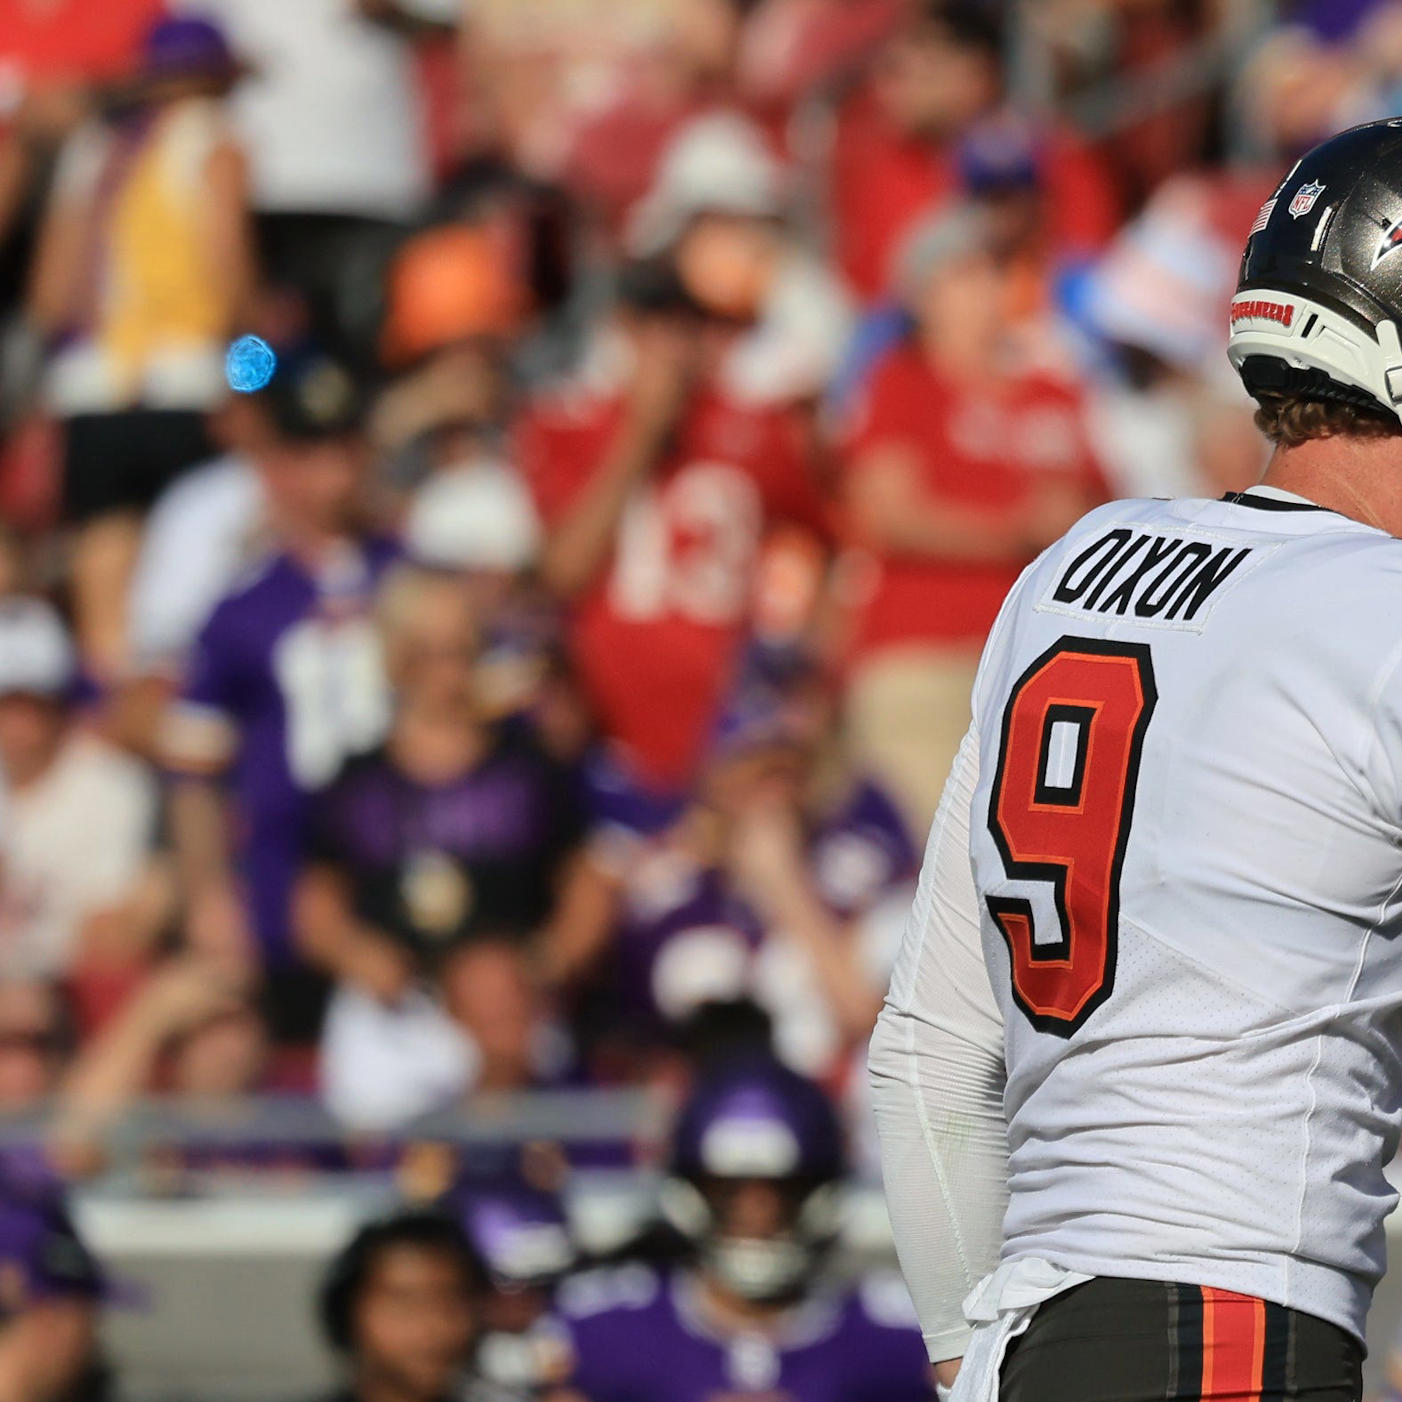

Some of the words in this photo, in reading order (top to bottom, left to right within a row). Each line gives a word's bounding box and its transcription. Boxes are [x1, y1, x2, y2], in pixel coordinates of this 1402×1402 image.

[1293, 195, 1312, 211] NFL
[1053, 529, 1252, 621] DIXON
[986, 635, 1158, 1040] 9
